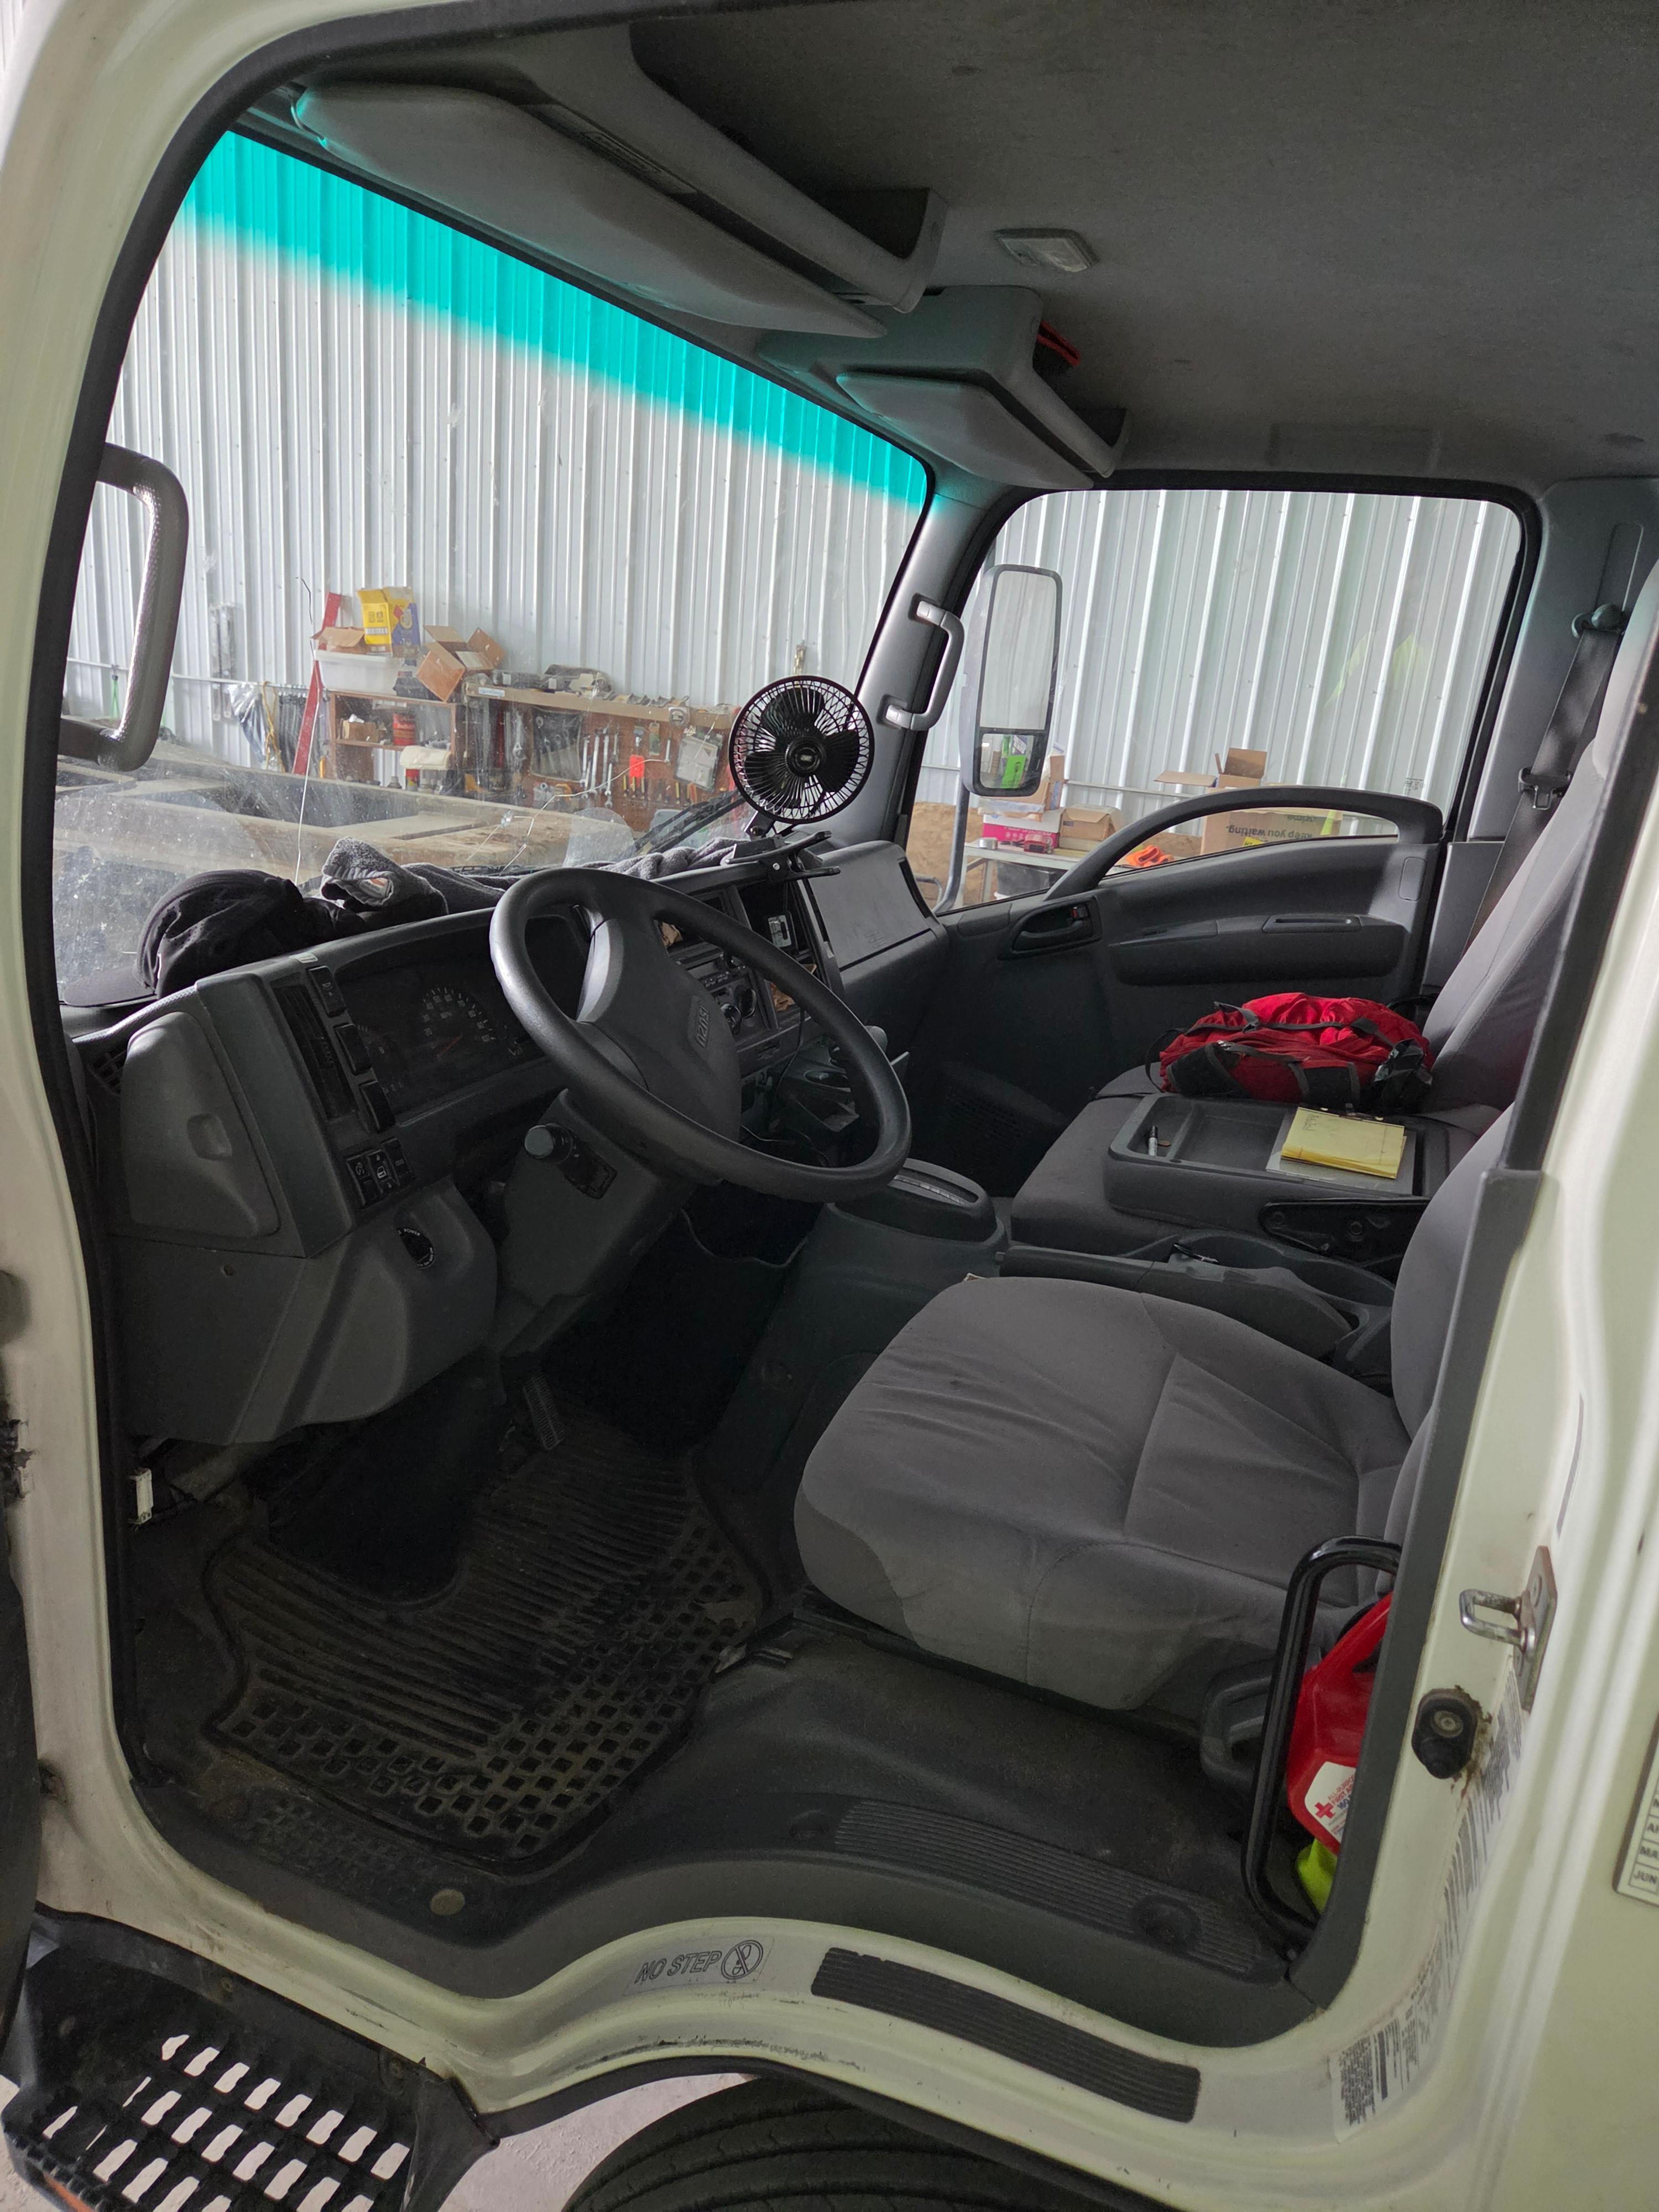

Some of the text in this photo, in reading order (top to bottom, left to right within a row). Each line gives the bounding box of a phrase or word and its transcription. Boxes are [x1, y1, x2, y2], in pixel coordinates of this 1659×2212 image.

[1225, 824, 1266, 837] waiting.
[1268, 829, 1287, 838] you
[1633, 1870, 1657, 1885] JUN
[634, 1950, 723, 1984] NO STEP
